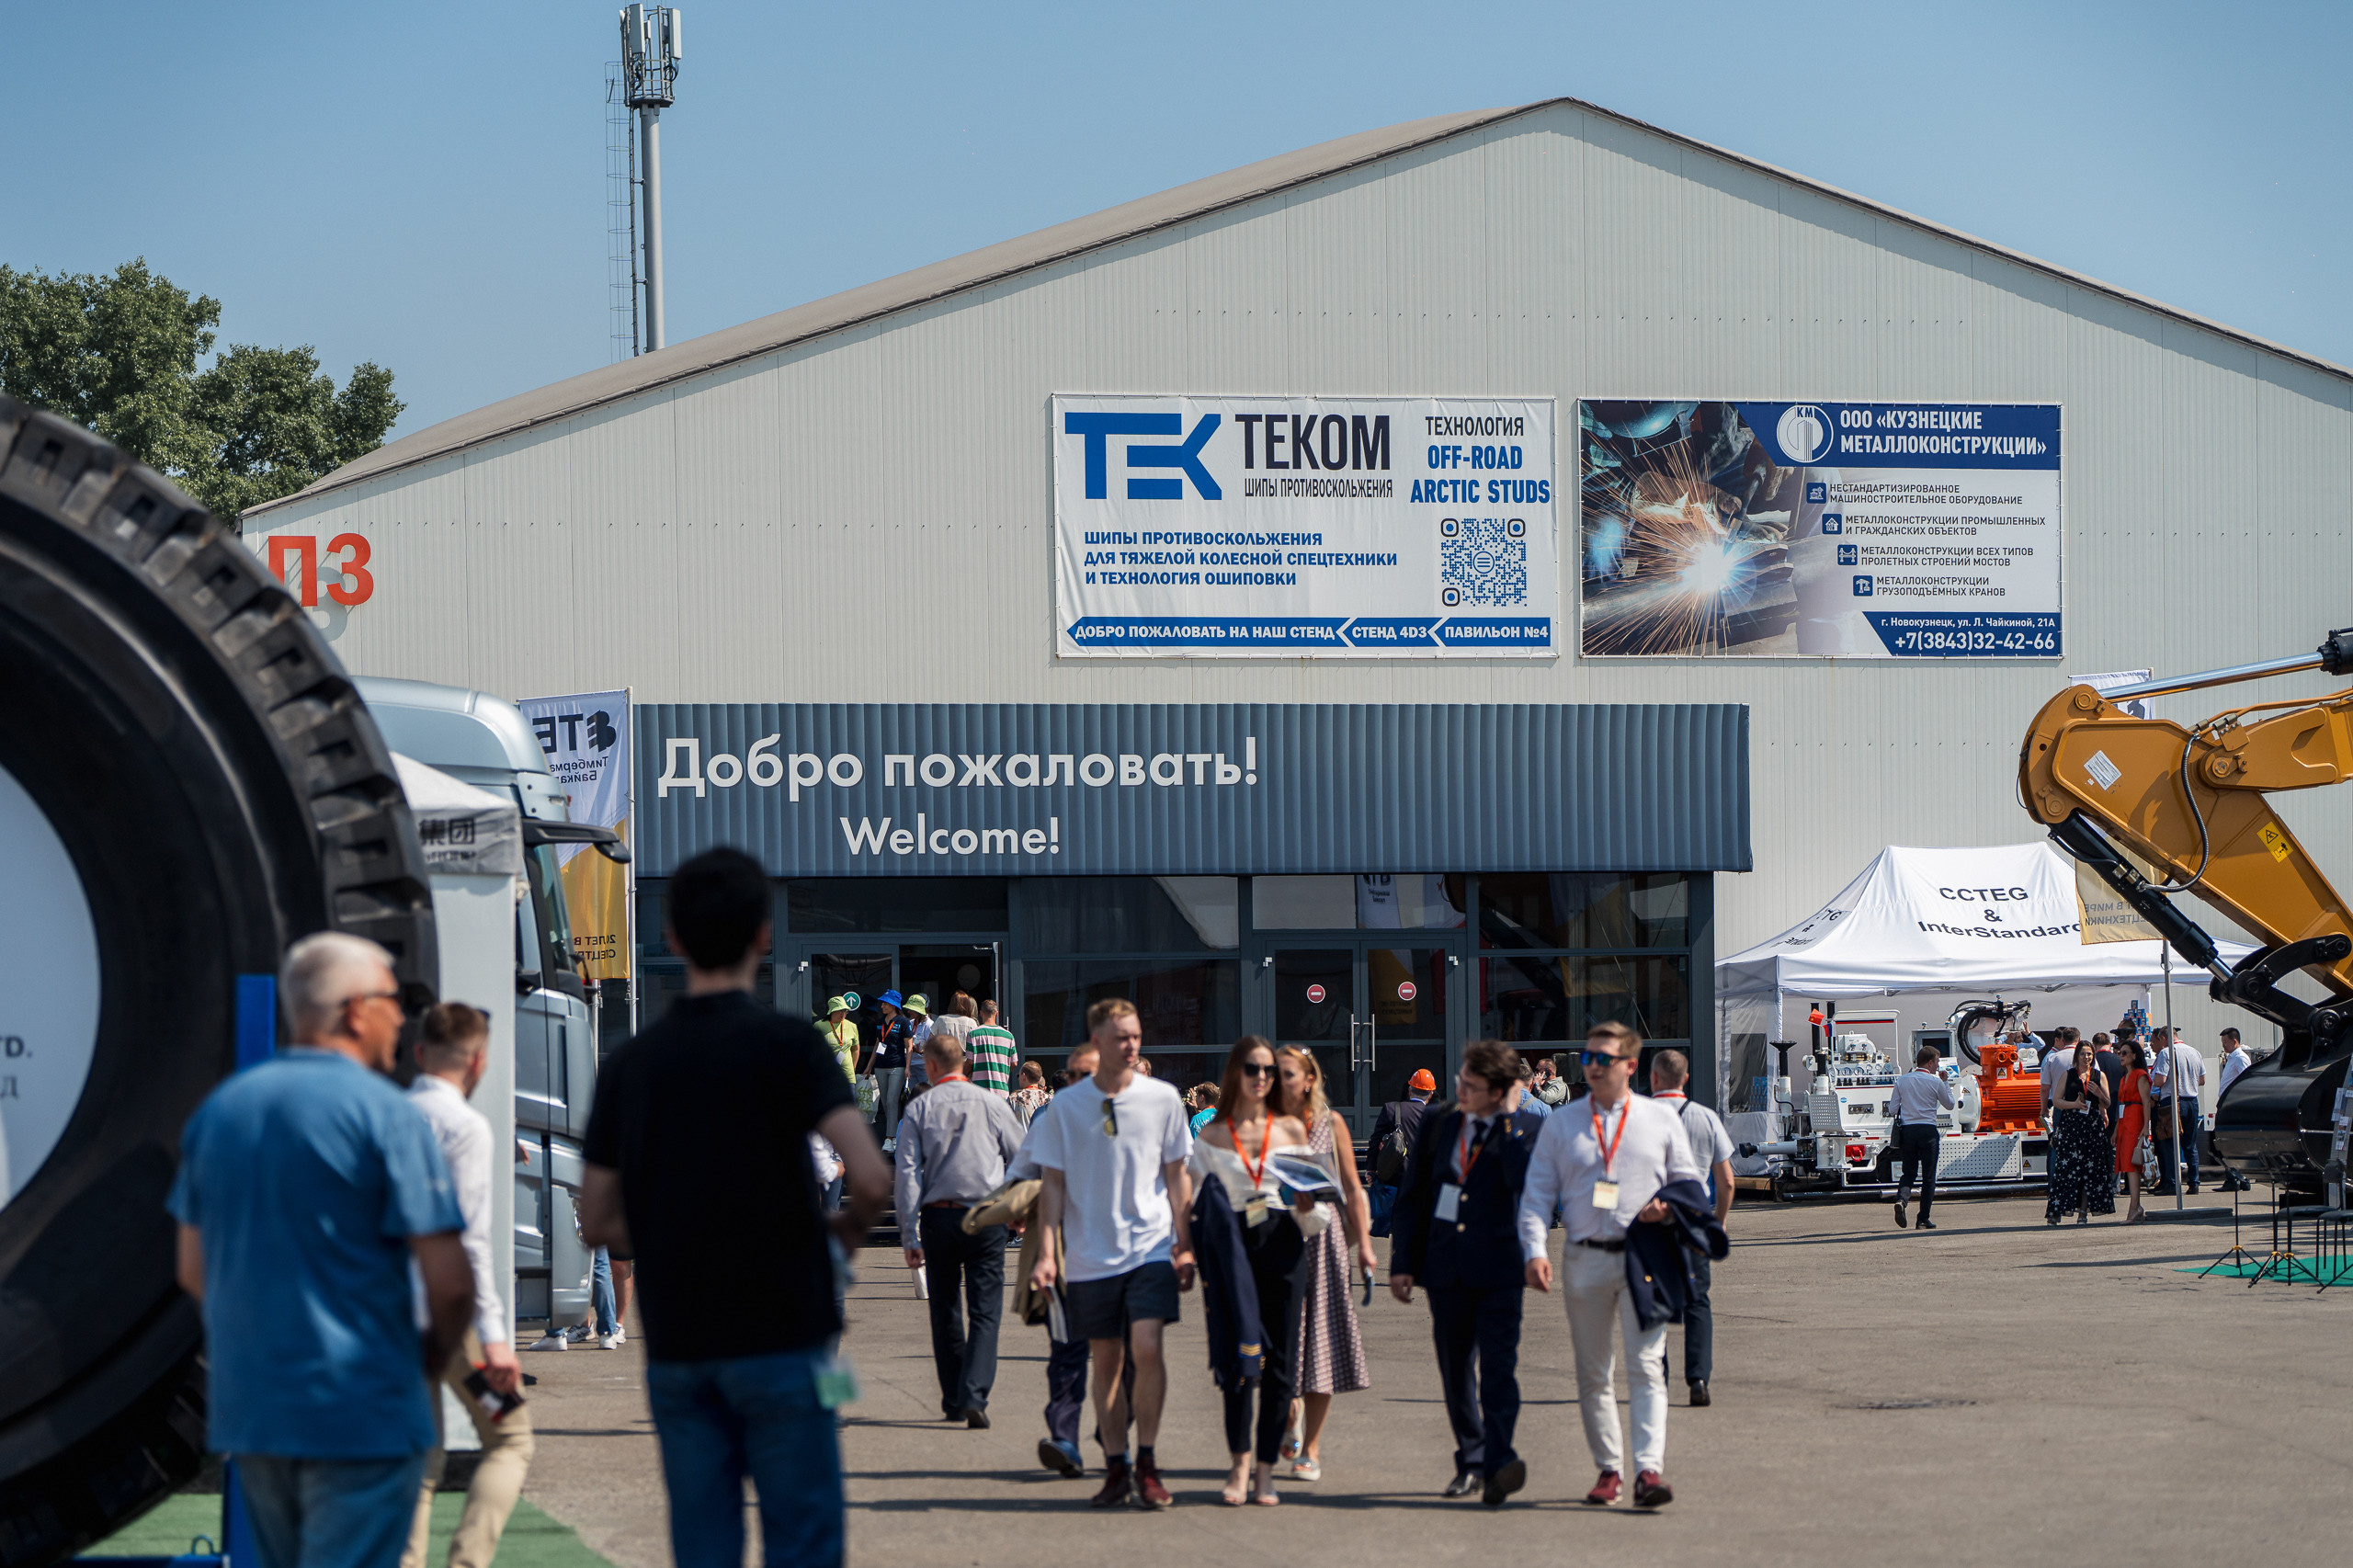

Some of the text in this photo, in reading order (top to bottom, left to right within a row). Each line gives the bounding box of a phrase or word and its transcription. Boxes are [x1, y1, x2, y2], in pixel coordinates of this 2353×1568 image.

[1796, 407, 1815, 418] КМ
[1426, 416, 1524, 437] ТЕХНОЛОГИЯ
[1840, 410, 1982, 432] ООО «КУЗНЕЦКИЕ
[1235, 414, 1391, 471] ТЕКОМ
[1840, 435, 2047, 458] МЕТАЛЛОКОНСТРУКЦИИ»
[1427, 445, 1523, 470] OFF-ROAD
[1244, 478, 1392, 498] ШИПЫ ПРОТИВОСКОЛЬЖЕНИЯ
[1410, 479, 1551, 504] ARCTIC STUDS
[1829, 483, 1960, 494] НЕСТАНДАРТИЗИРОВАННОЕ
[1829, 494, 2023, 506] МАШИНОСТРОИТЕЛЬНОЕ ОБОРУДОВАНИЕ
[1846, 516, 2046, 527] МЕТАЛЛОКОНСТРУКЦИИ ПРОМЫШЛЕННЫХ
[1085, 531, 1323, 545] ШИПЫ ПРОТИВОСКОЛЬЖЕНИЯ
[1846, 526, 1977, 537] И ГРАЖДАНСКИХ ОБЪЕКТОВ
[1085, 548, 1397, 567] ДЛЯ ТЯЖЕЛОЙ КОЛЕСНОЙ СПЕЦТЕХНИКИ
[1861, 546, 2034, 557] МЕТАЛЛОКОНСТРУКЦИИ ВСЕХ ТИПОВ
[1861, 556, 2011, 566] ПРОЛЕТНЫХ СТРОЕНИЙ МОСТОВ
[1086, 572, 1296, 585] И ТЕХНОЛОГИЯ ОШИПОВКИ
[1876, 576, 1989, 586] МЕТАЛЛОКОНСТРУКЦИИ
[1876, 585, 2006, 597] ГРУЗОПОДЪЁМНЫХ КРАНОВ
[1891, 618, 1955, 628] Новокузнецк,
[1957, 619, 1971, 629] ул.
[1973, 618, 1984, 627] Л.
[1985, 617, 2035, 628] Чайкиной,
[1075, 626, 1549, 640] ДОБРО ПОЖАЛОВАТЬ НА НАШ СТЕНД СТЕНД 4D3 ПАВИЛЬОН №4
[1895, 631, 2055, 651] +7(3843)32-42-66
[657, 733, 1257, 802] Добро пожаловать!
[839, 812, 1060, 856] Welcome!
[1939, 887, 2029, 902] CCTEG
[1984, 909, 2003, 922] &
